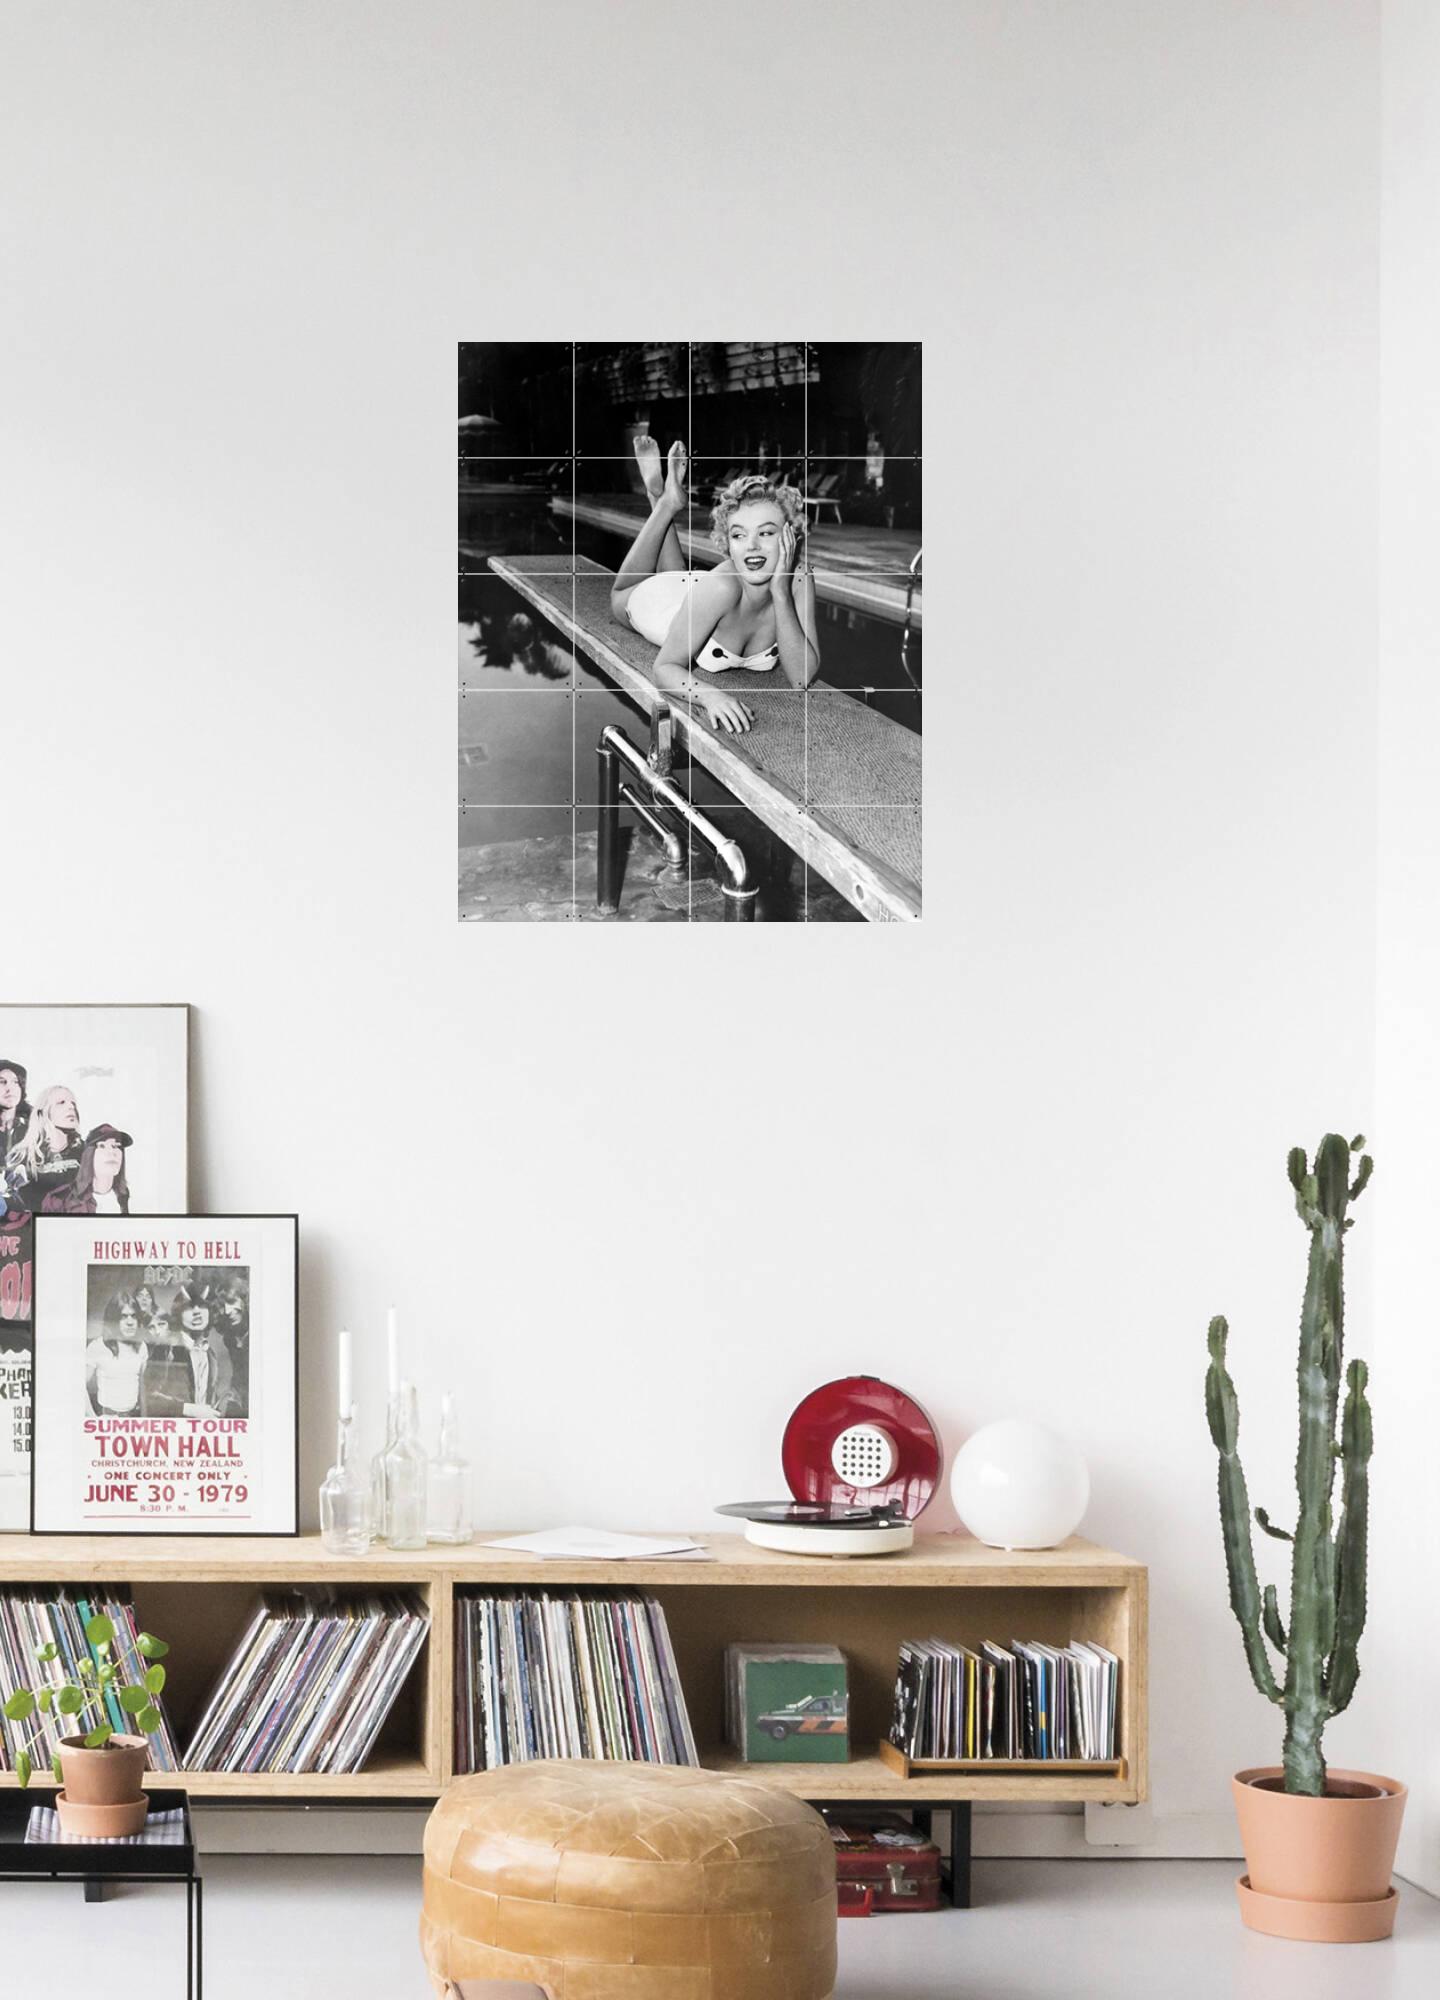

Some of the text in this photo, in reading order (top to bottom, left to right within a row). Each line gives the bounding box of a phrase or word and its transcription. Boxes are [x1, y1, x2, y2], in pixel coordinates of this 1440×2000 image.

[94, 1241, 241, 1259] HIGHWAY TO HELL
[143, 1265, 194, 1286] AC/DC
[83, 1419, 248, 1434] SUMMER TOUR
[94, 1435, 241, 1458] TOWN HALL
[104, 1471, 231, 1481] ONE CONCERT ONLY
[83, 1484, 138, 1503] JUNE
[148, 1484, 175, 1503] 30
[197, 1484, 248, 1503] 1979
